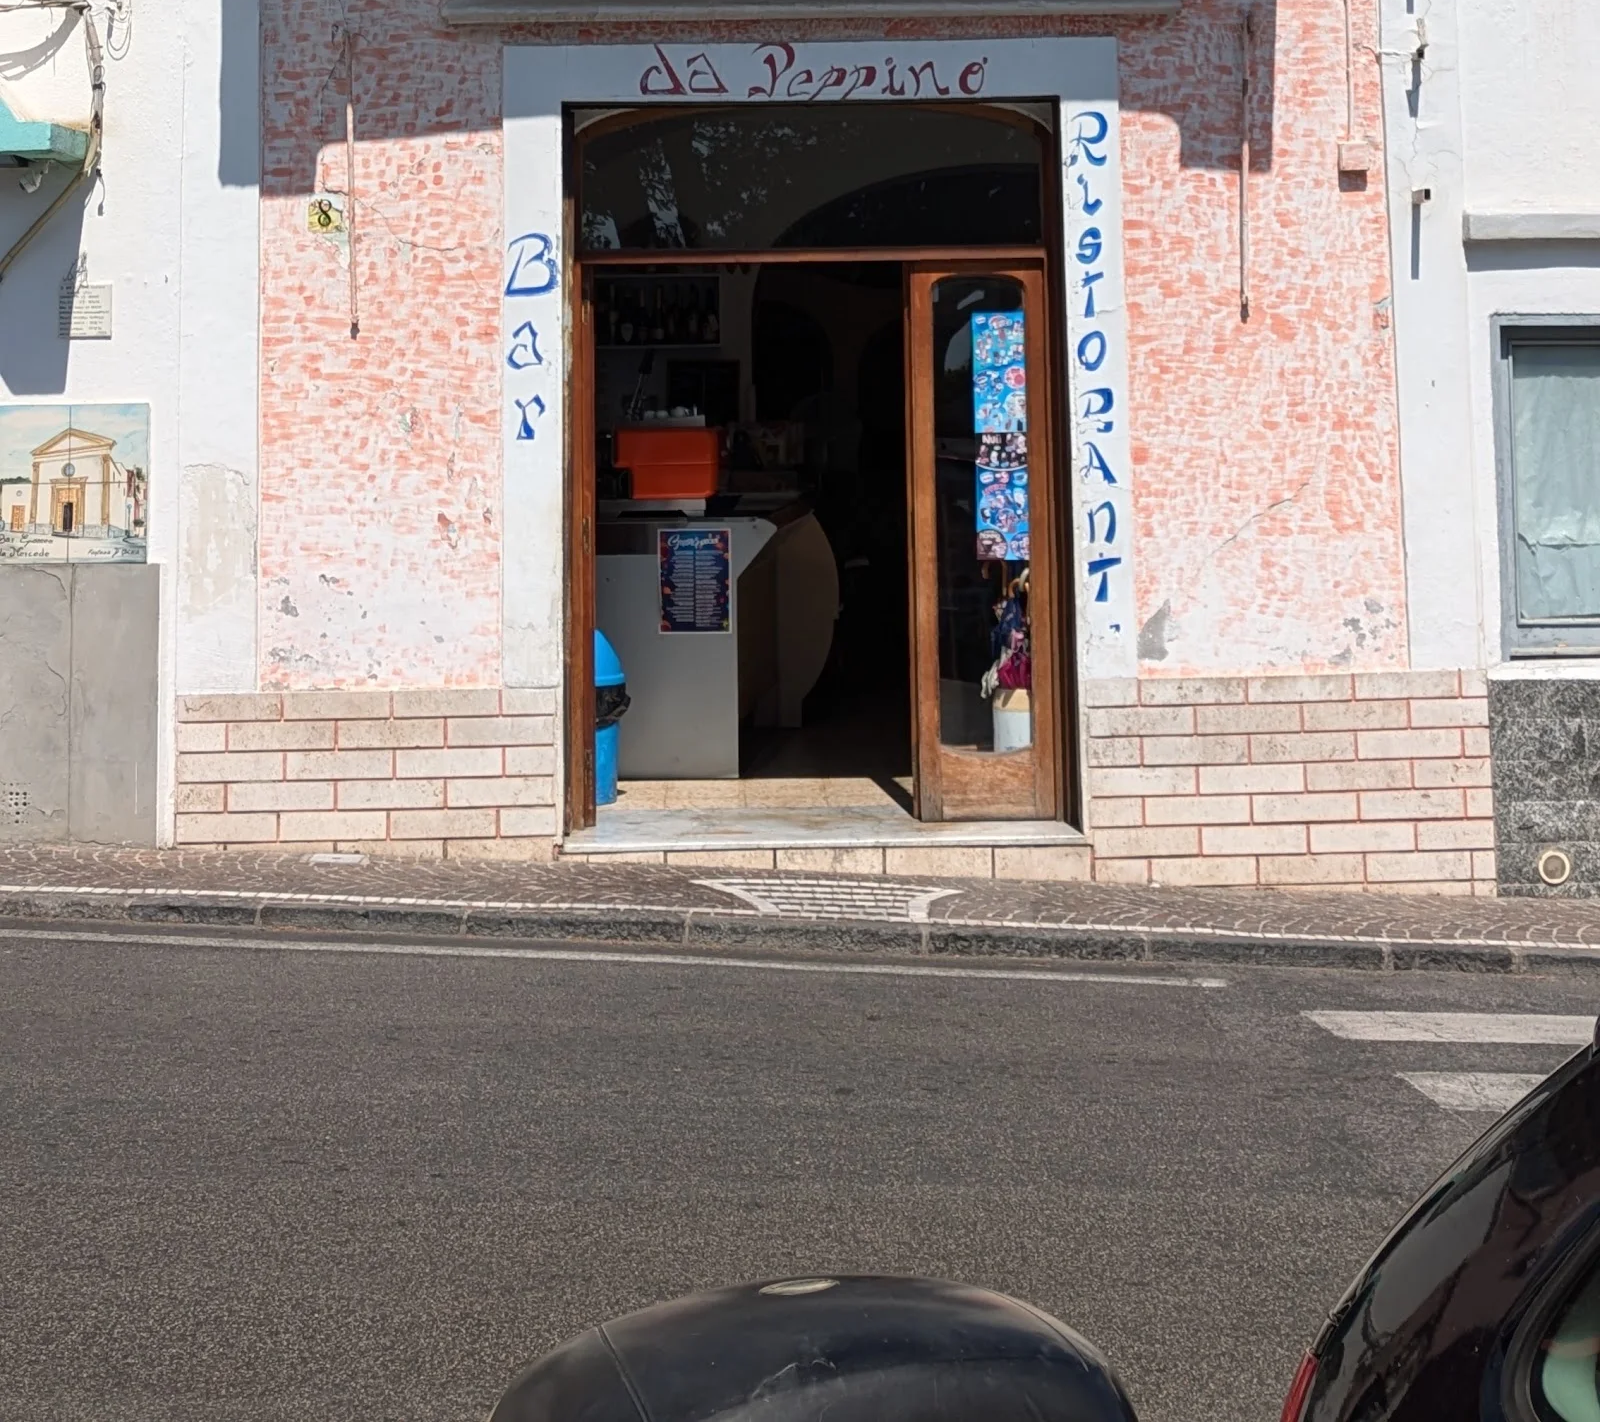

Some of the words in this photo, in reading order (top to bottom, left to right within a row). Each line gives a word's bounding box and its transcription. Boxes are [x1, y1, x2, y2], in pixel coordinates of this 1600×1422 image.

[639, 42, 729, 96] da
[747, 42, 989, 100] Peppino
[318, 199, 332, 227] 8
[504, 232, 559, 440] Bar
